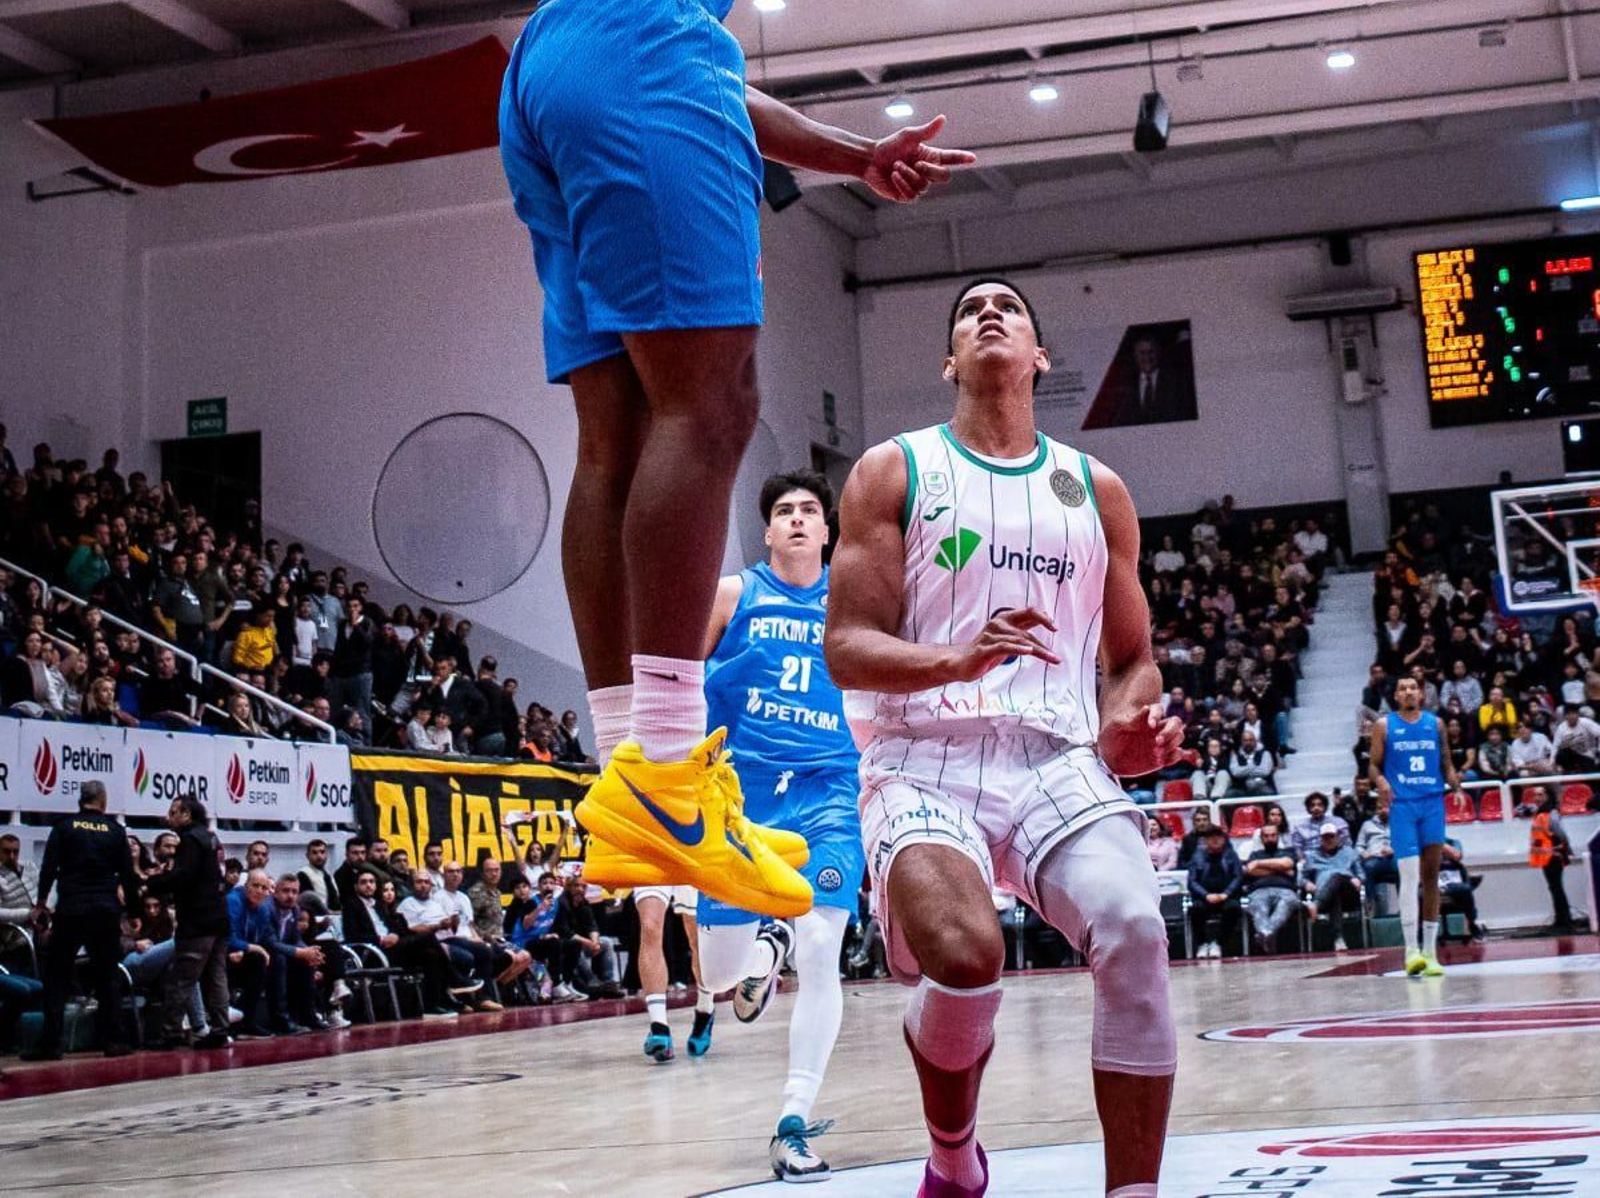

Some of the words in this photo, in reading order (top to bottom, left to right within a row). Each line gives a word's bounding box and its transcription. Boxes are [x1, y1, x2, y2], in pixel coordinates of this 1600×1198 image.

[988, 544, 1075, 584] Unicaja
[749, 617, 809, 643] PETKIM
[779, 655, 812, 693] 21
[764, 702, 839, 731] PETKIM
[61, 745, 113, 773] Petkim
[249, 759, 290, 785] Petkim
[152, 772, 209, 802] SOCAR
[249, 790, 278, 806] SPOR
